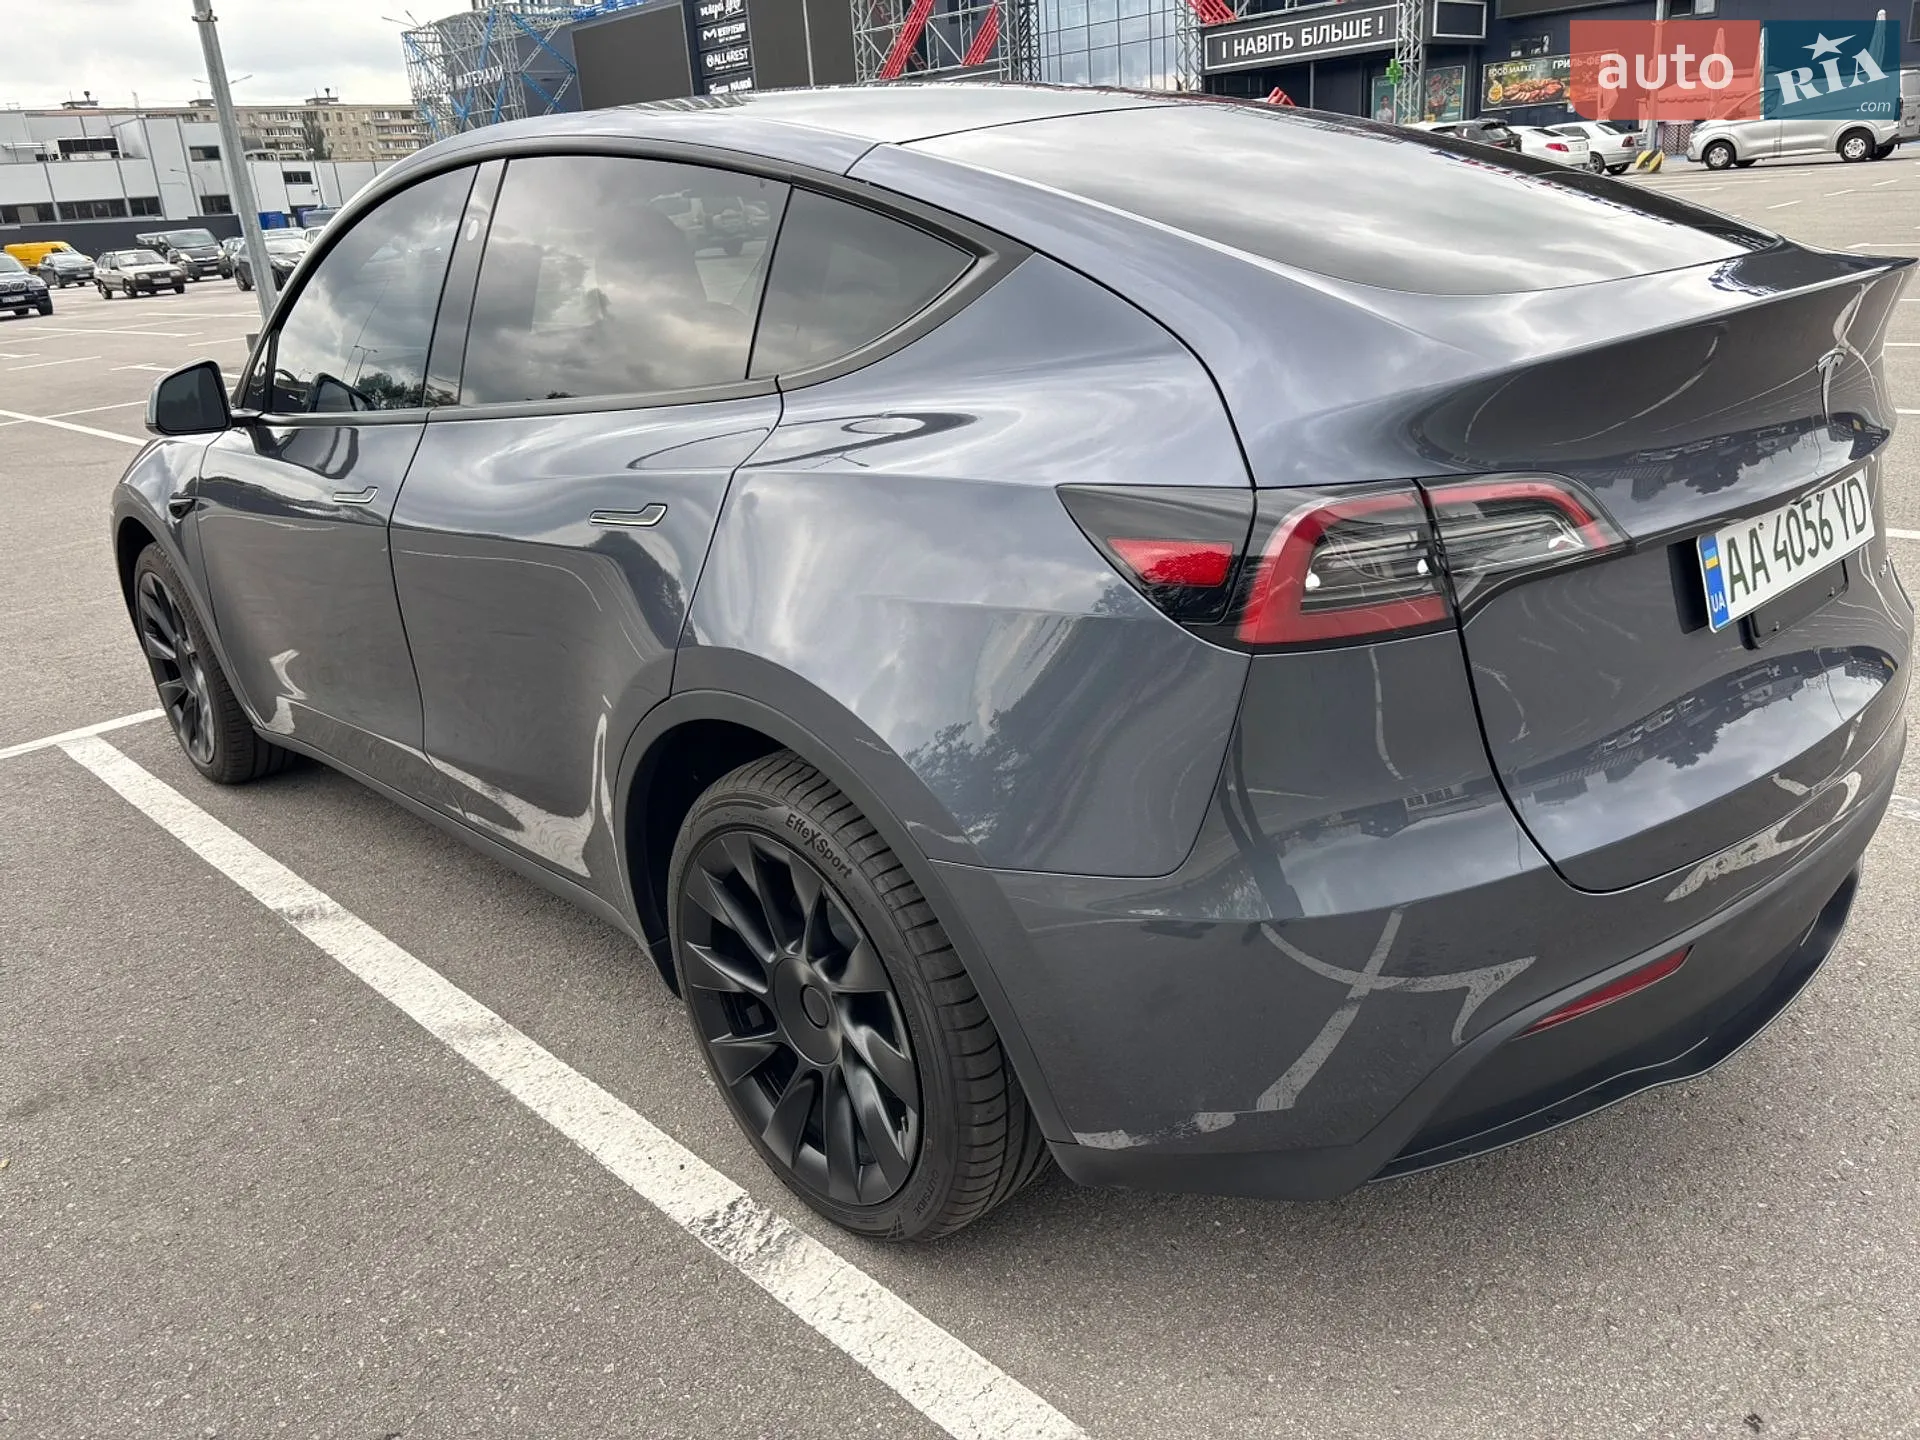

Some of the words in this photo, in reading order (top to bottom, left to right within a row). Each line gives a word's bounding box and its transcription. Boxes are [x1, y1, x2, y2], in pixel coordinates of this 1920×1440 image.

[1222, 41, 1227, 59] І
[1233, 31, 1294, 57] НАВІТЬ
[1301, 17, 1372, 47] БІЛЬШЕ
[1552, 54, 1610, 71] ГРИЛЬ-ФЕ
[1726, 526, 1771, 604] AA
[1773, 493, 1834, 573] 4056
[1832, 476, 1867, 541] YD
[1710, 590, 1727, 613] UA
[785, 812, 853, 879] EffeXSport
